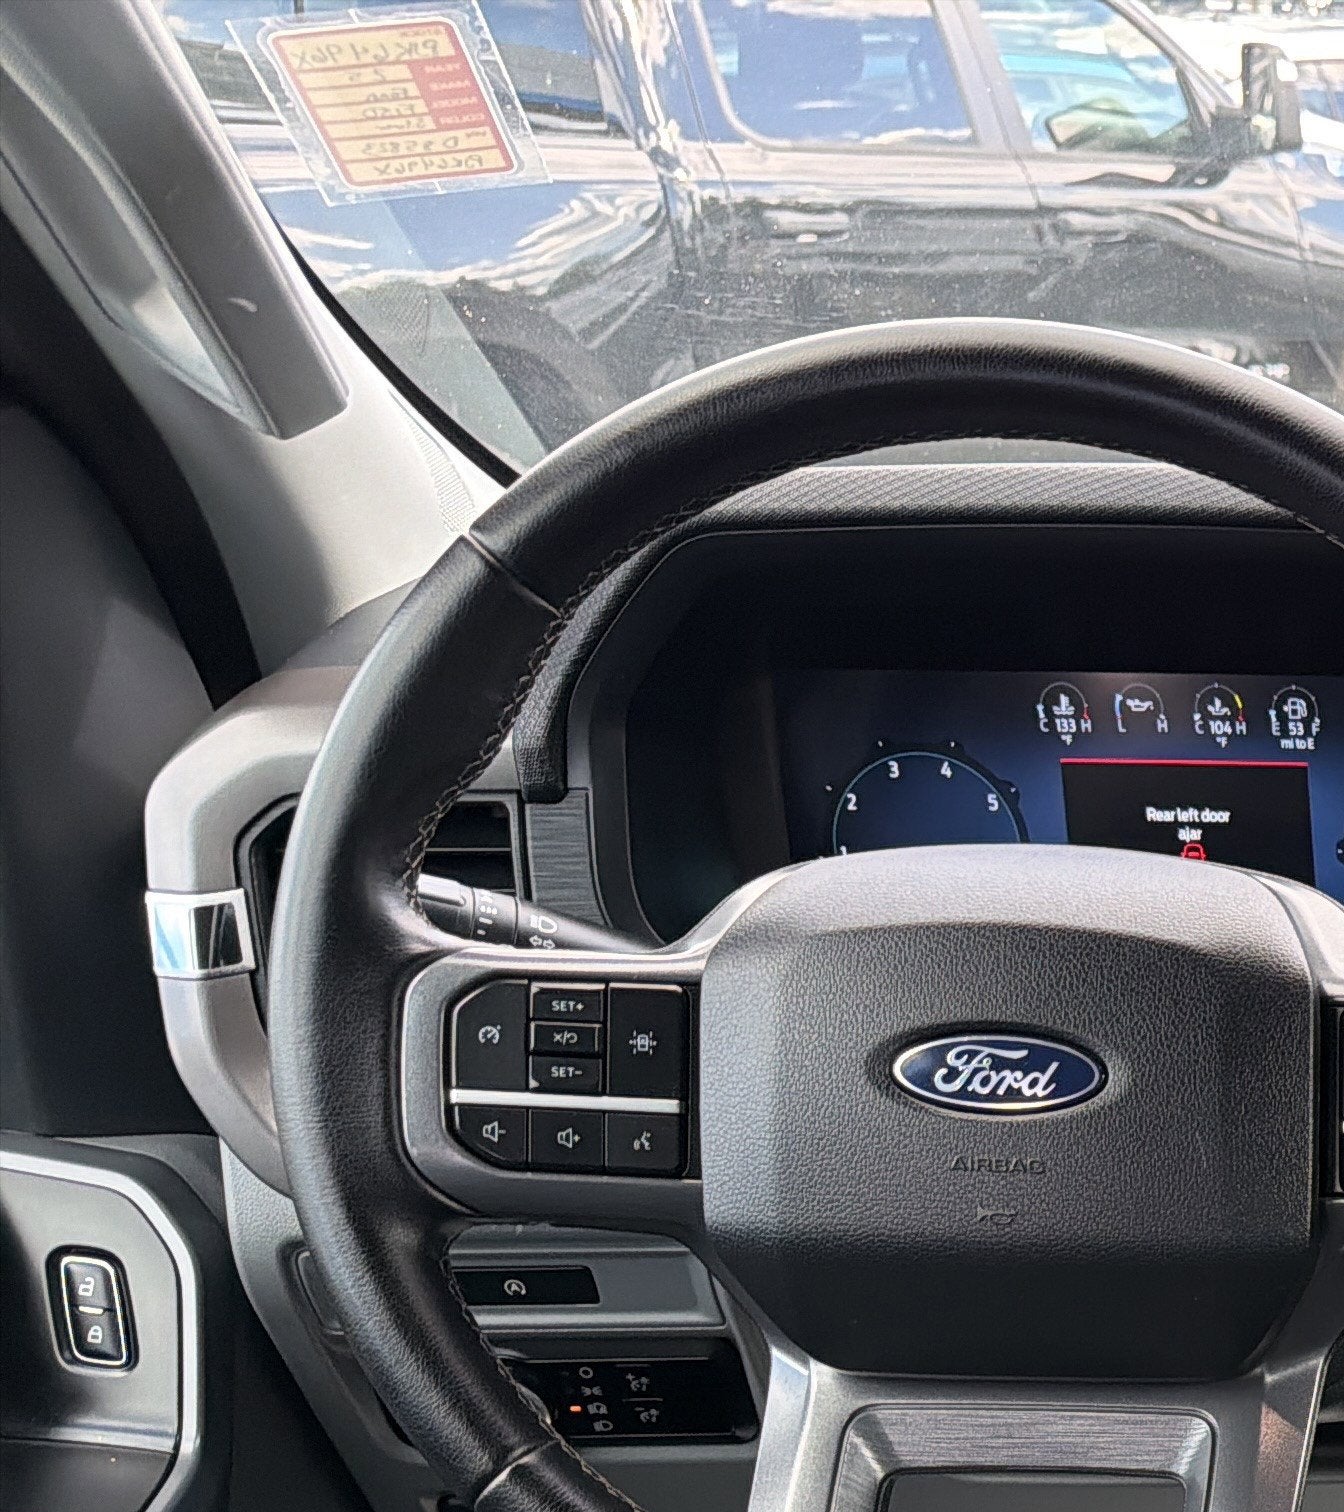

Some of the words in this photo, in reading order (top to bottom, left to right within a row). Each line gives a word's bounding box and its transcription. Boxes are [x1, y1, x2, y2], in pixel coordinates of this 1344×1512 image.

[1040, 719, 1049, 733] C
[1055, 718, 1076, 733] 133
[1081, 719, 1092, 733] H
[1118, 719, 1126, 733] L
[1157, 719, 1168, 733] H
[1195, 721, 1204, 735] C
[1209, 720, 1232, 735] 104
[1235, 720, 1246, 735] H
[1271, 722, 1280, 736] E
[1288, 722, 1305, 736] 53
[1312, 722, 1320, 737] F
[1307, 739, 1315, 750] E
[888, 760, 900, 779] 3
[940, 761, 953, 779] 4
[847, 793, 858, 811] 2
[987, 794, 999, 811] 5
[1146, 807, 1175, 822] Rear
[1176, 807, 1199, 822] left
[1201, 808, 1231, 823] door
[1178, 829, 1202, 843] ajar
[551, 1001, 585, 1012] SET+
[934, 1044, 1057, 1097] Ford
[950, 1157, 1046, 1174] AIRBAG
